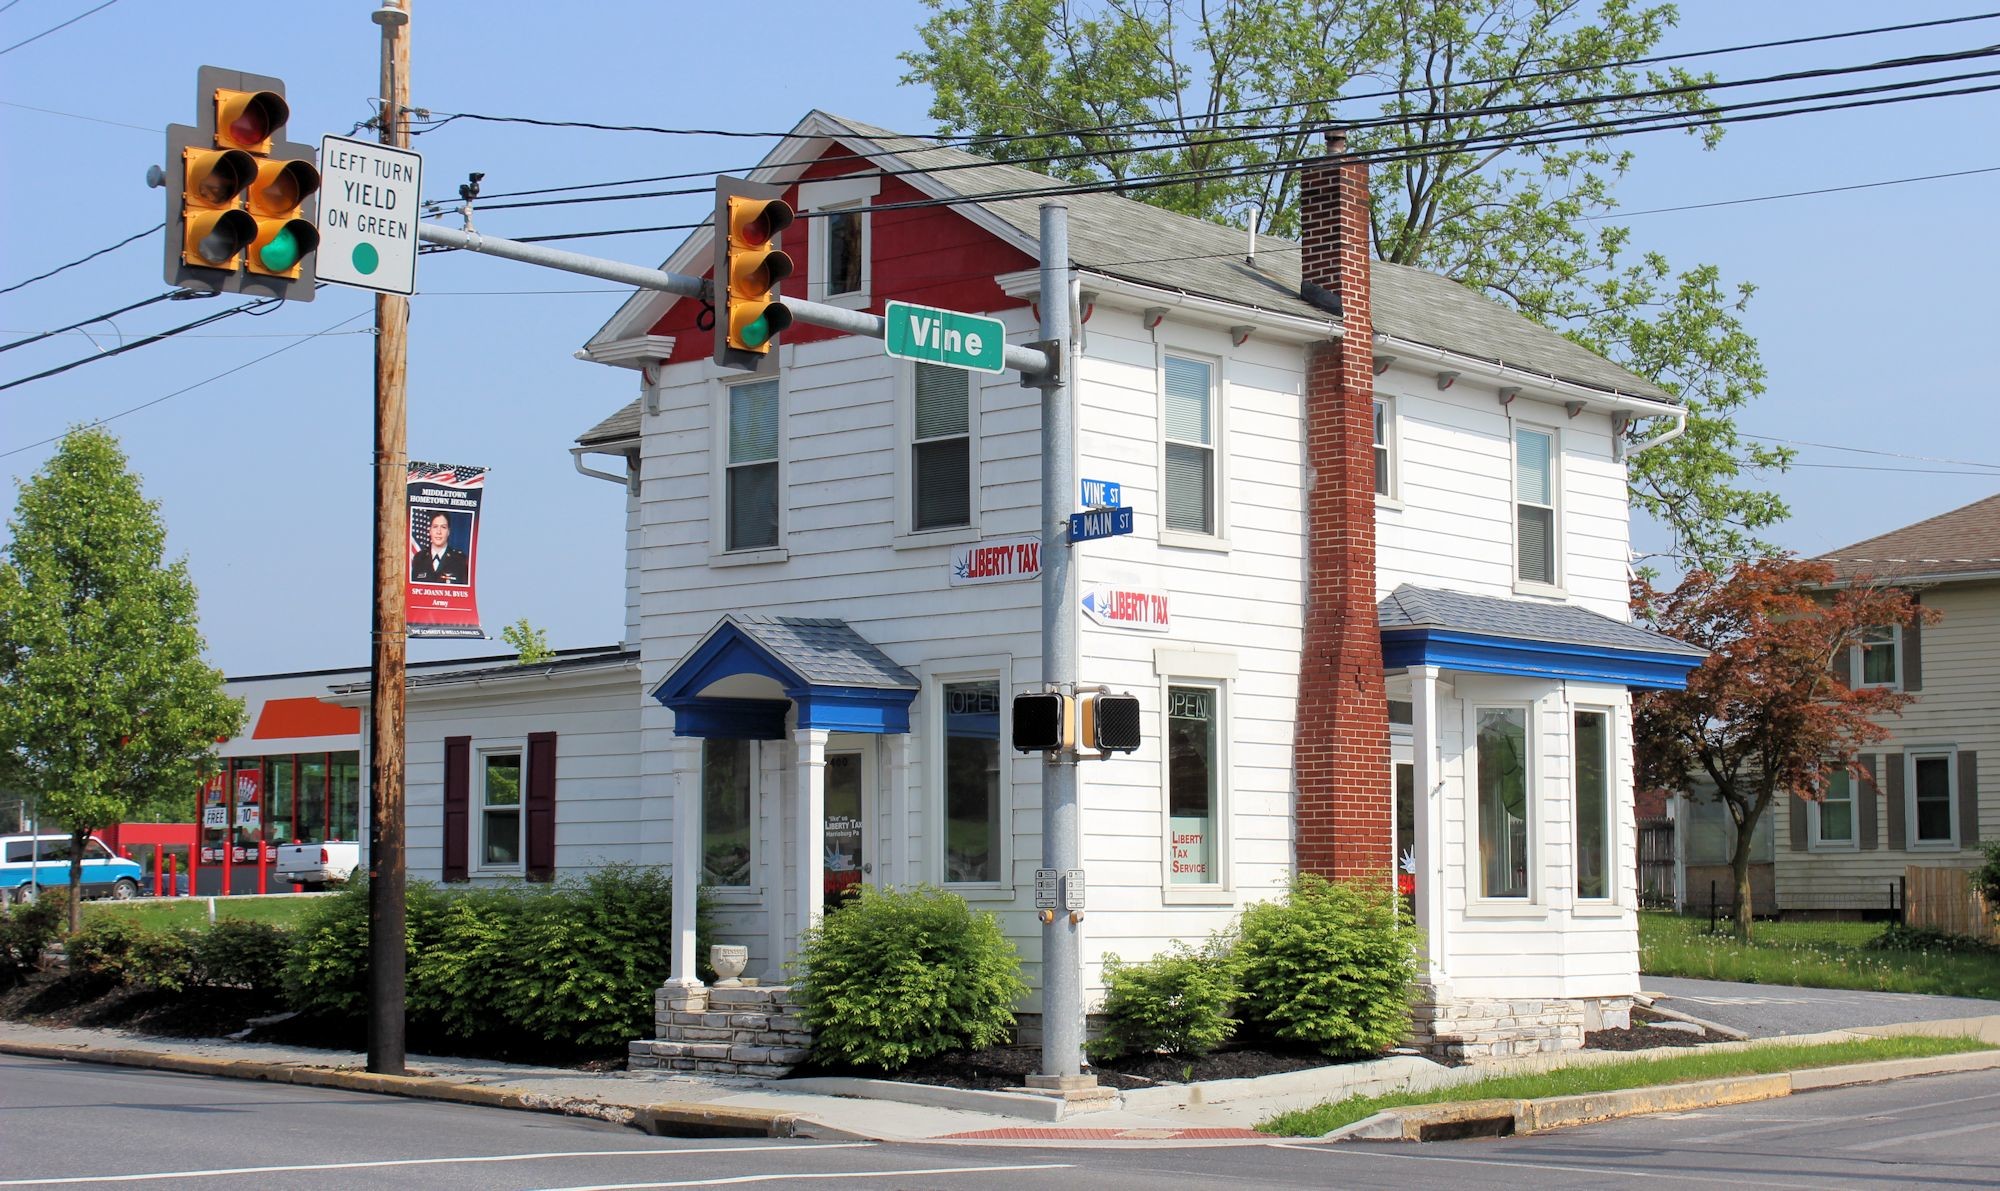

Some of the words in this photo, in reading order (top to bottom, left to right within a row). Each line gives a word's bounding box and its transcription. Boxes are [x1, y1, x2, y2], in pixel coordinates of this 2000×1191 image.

[330, 150, 366, 173] LEFT
[374, 159, 412, 183] TURN
[344, 180, 396, 210] YIELD
[328, 209, 348, 229] ON
[357, 214, 407, 240] GREEN
[910, 315, 983, 356] Vine
[422, 488, 467, 498] MIDDLETOWN
[1083, 481, 1106, 505] VINE
[1110, 488, 1119, 503] ST
[410, 495, 449, 505] HOMETOWN
[450, 499, 477, 507] HEROES
[1072, 519, 1078, 535] E
[1084, 512, 1112, 537] MAIN
[1120, 513, 1130, 529] ST
[968, 545, 1014, 578] LIBERTY
[1017, 543, 1039, 573] TAX
[423, 589, 443, 597] JOANN
[432, 599, 448, 607] Army
[1109, 590, 1149, 623] LIBERTY
[1151, 594, 1168, 625] TAX
[207, 812, 224, 824] FREE
[825, 820, 849, 830] LIBERTY
[1172, 831, 1203, 844] LIBERTY
[1172, 846, 1188, 858] TAX
[1172, 860, 1206, 873] SERVICE
